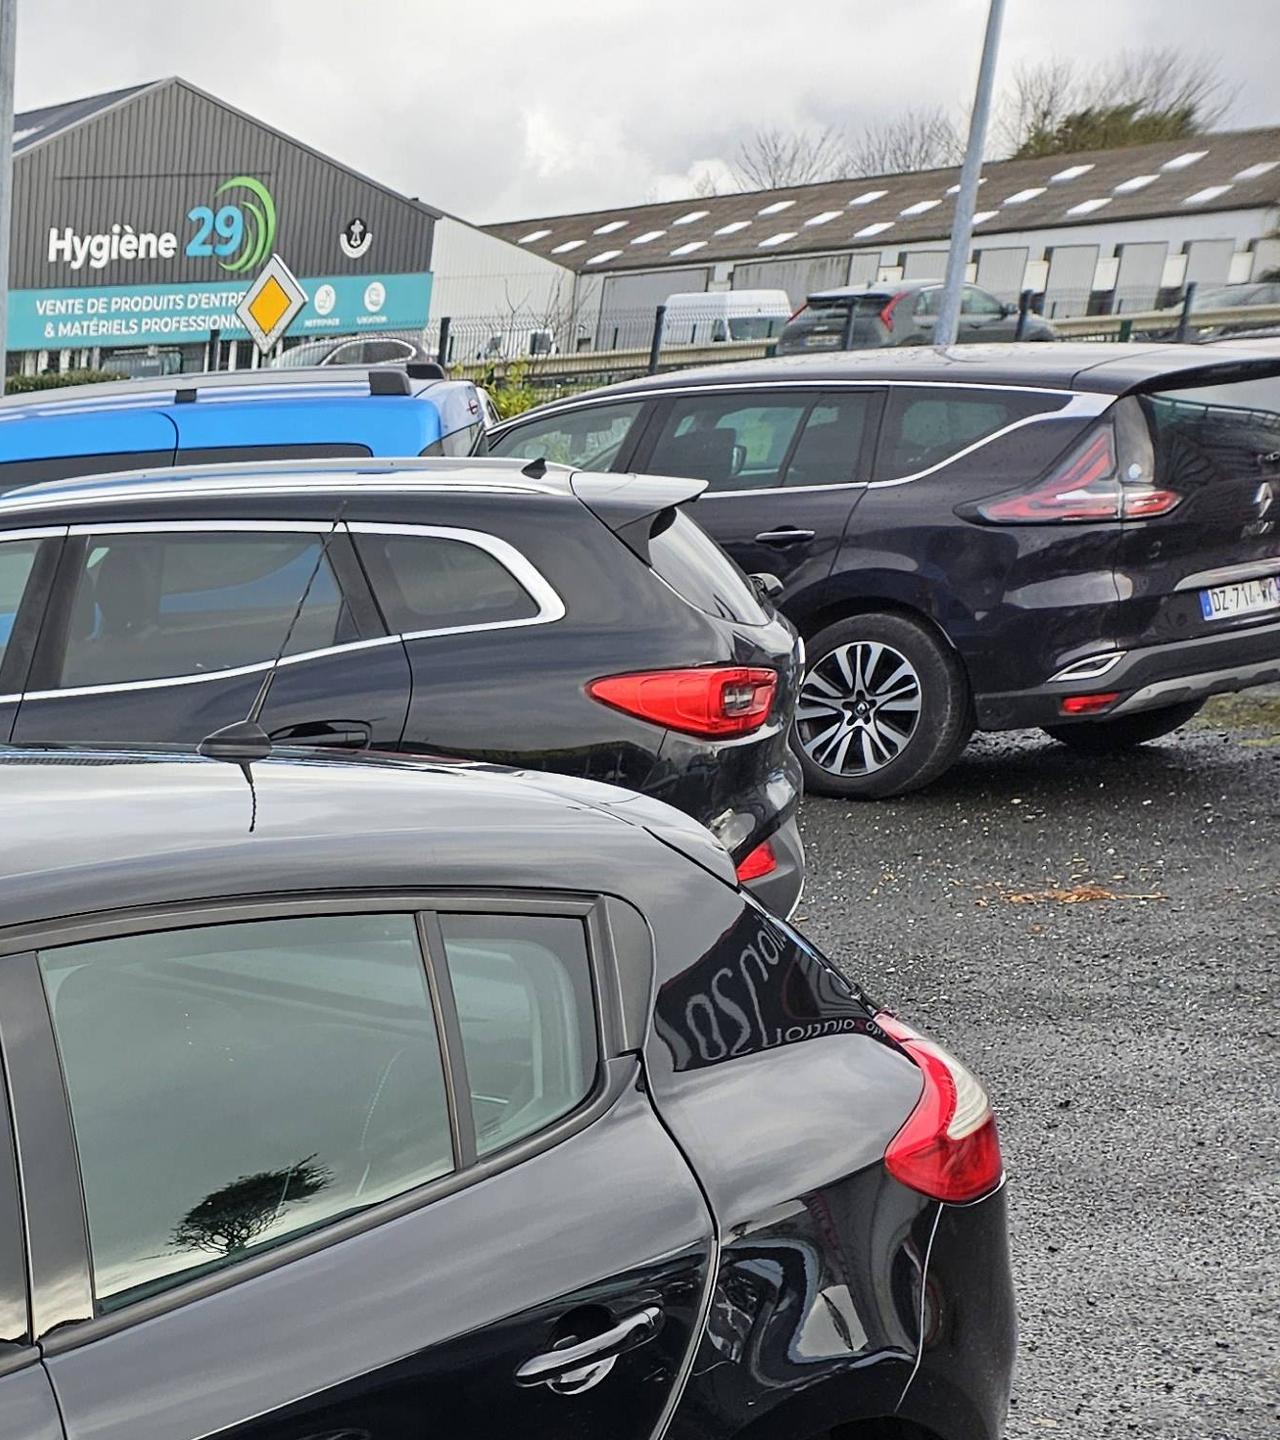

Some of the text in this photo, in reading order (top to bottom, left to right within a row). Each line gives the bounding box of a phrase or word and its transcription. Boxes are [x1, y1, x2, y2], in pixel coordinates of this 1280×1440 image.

[48, 204, 245, 270] Hygiène 29
[36, 291, 246, 316] VENTE DE PRODUITS D'ENTRE
[44, 314, 245, 338] & MATÉRIELS PROFESSIONN
